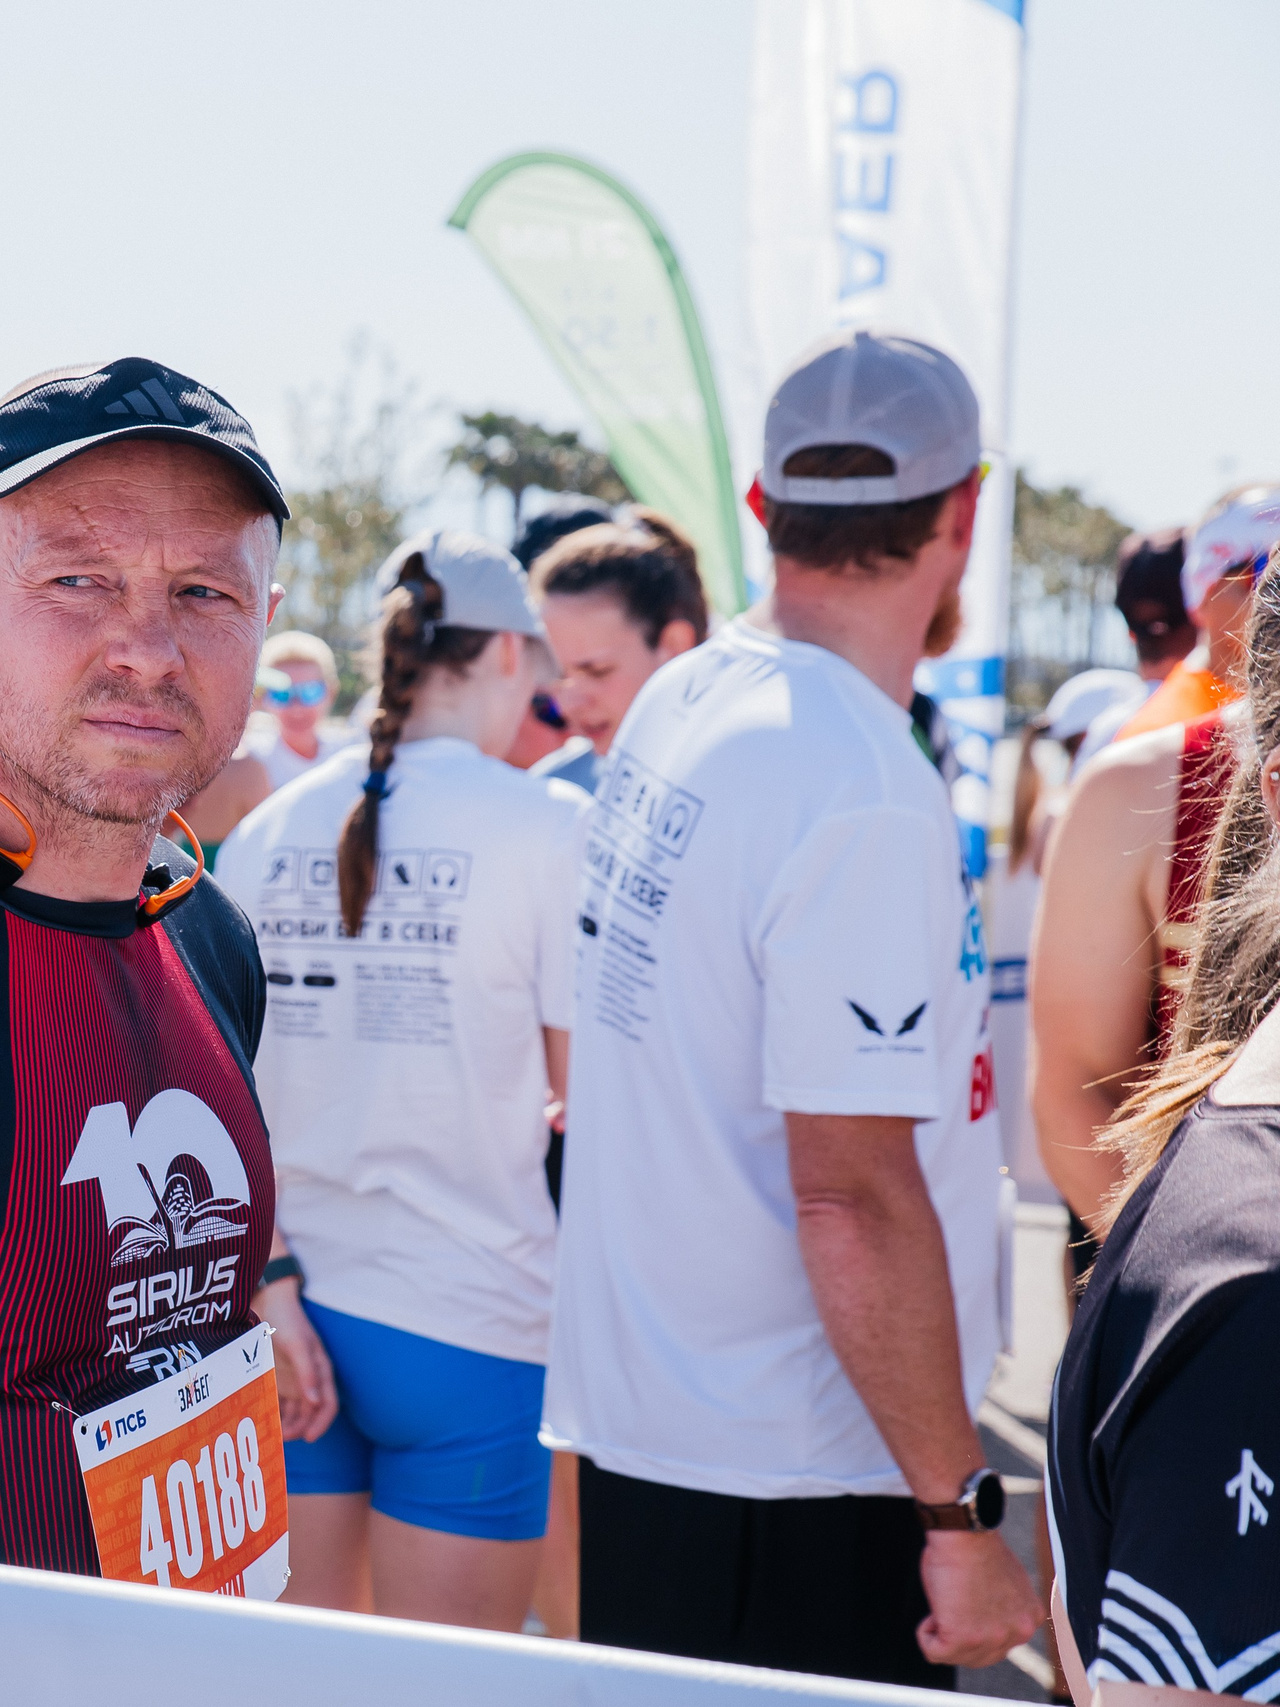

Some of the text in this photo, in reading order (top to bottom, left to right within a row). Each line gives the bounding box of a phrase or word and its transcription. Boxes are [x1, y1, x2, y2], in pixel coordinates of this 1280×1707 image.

[106, 1254, 241, 1327] SIRIUS
[104, 1299, 231, 1357] AUTODROM
[115, 1409, 147, 1438] ПСБ
[140, 1416, 267, 1590] 40188
